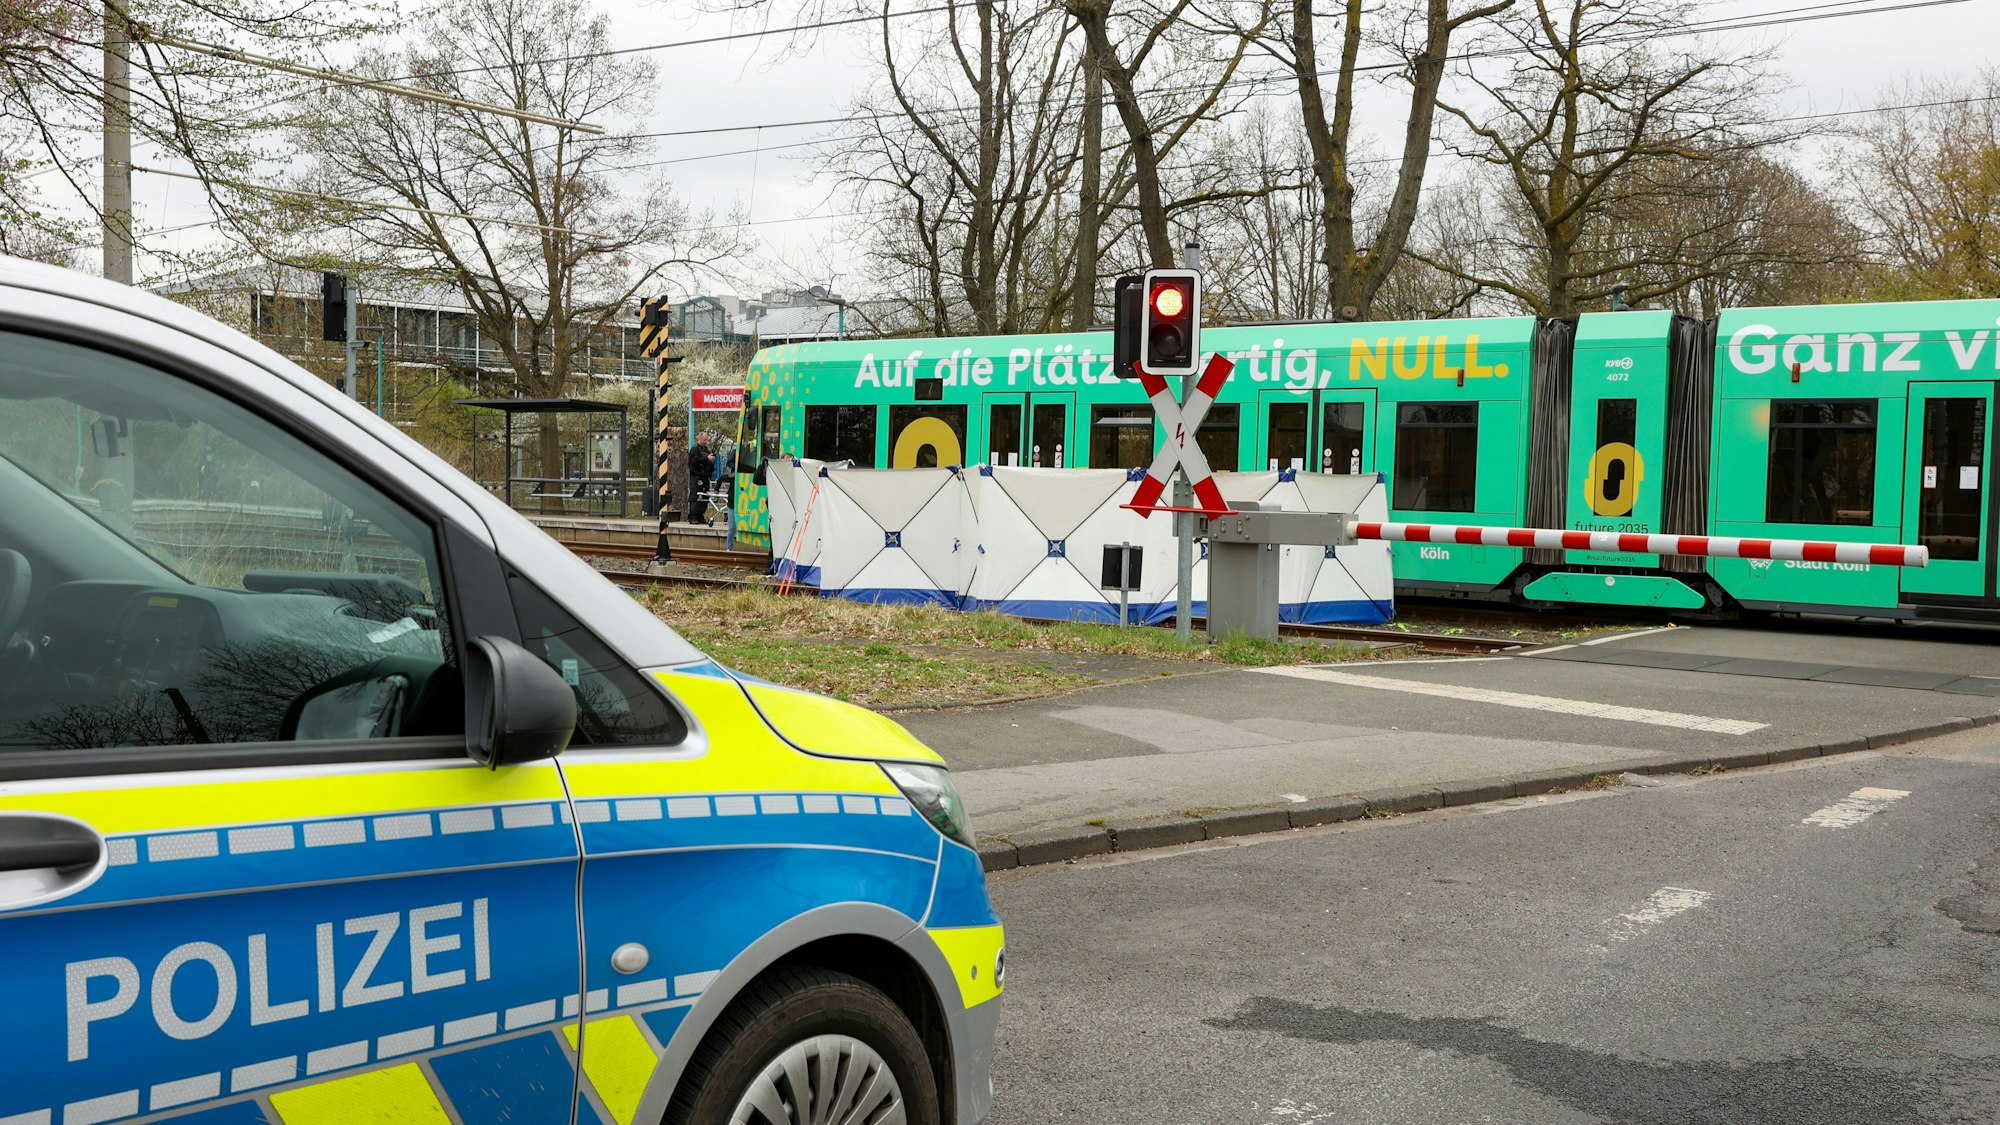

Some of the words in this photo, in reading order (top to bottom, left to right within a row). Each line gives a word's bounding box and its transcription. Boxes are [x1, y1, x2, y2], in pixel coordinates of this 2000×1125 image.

[1728, 324, 1921, 374] Ganz
[854, 349, 924, 387] Auf
[934, 348, 994, 386] die
[1007, 344, 1148, 385] Plätz
[1348, 334, 1509, 380] NULL.
[1607, 373, 1630, 382] 4072
[703, 394, 743, 403] MARSDORF
[1575, 521, 1614, 532] future
[1618, 523, 1649, 534] 2035
[1420, 546, 1450, 560] Köln
[65, 897, 492, 1063] POLIZEI
